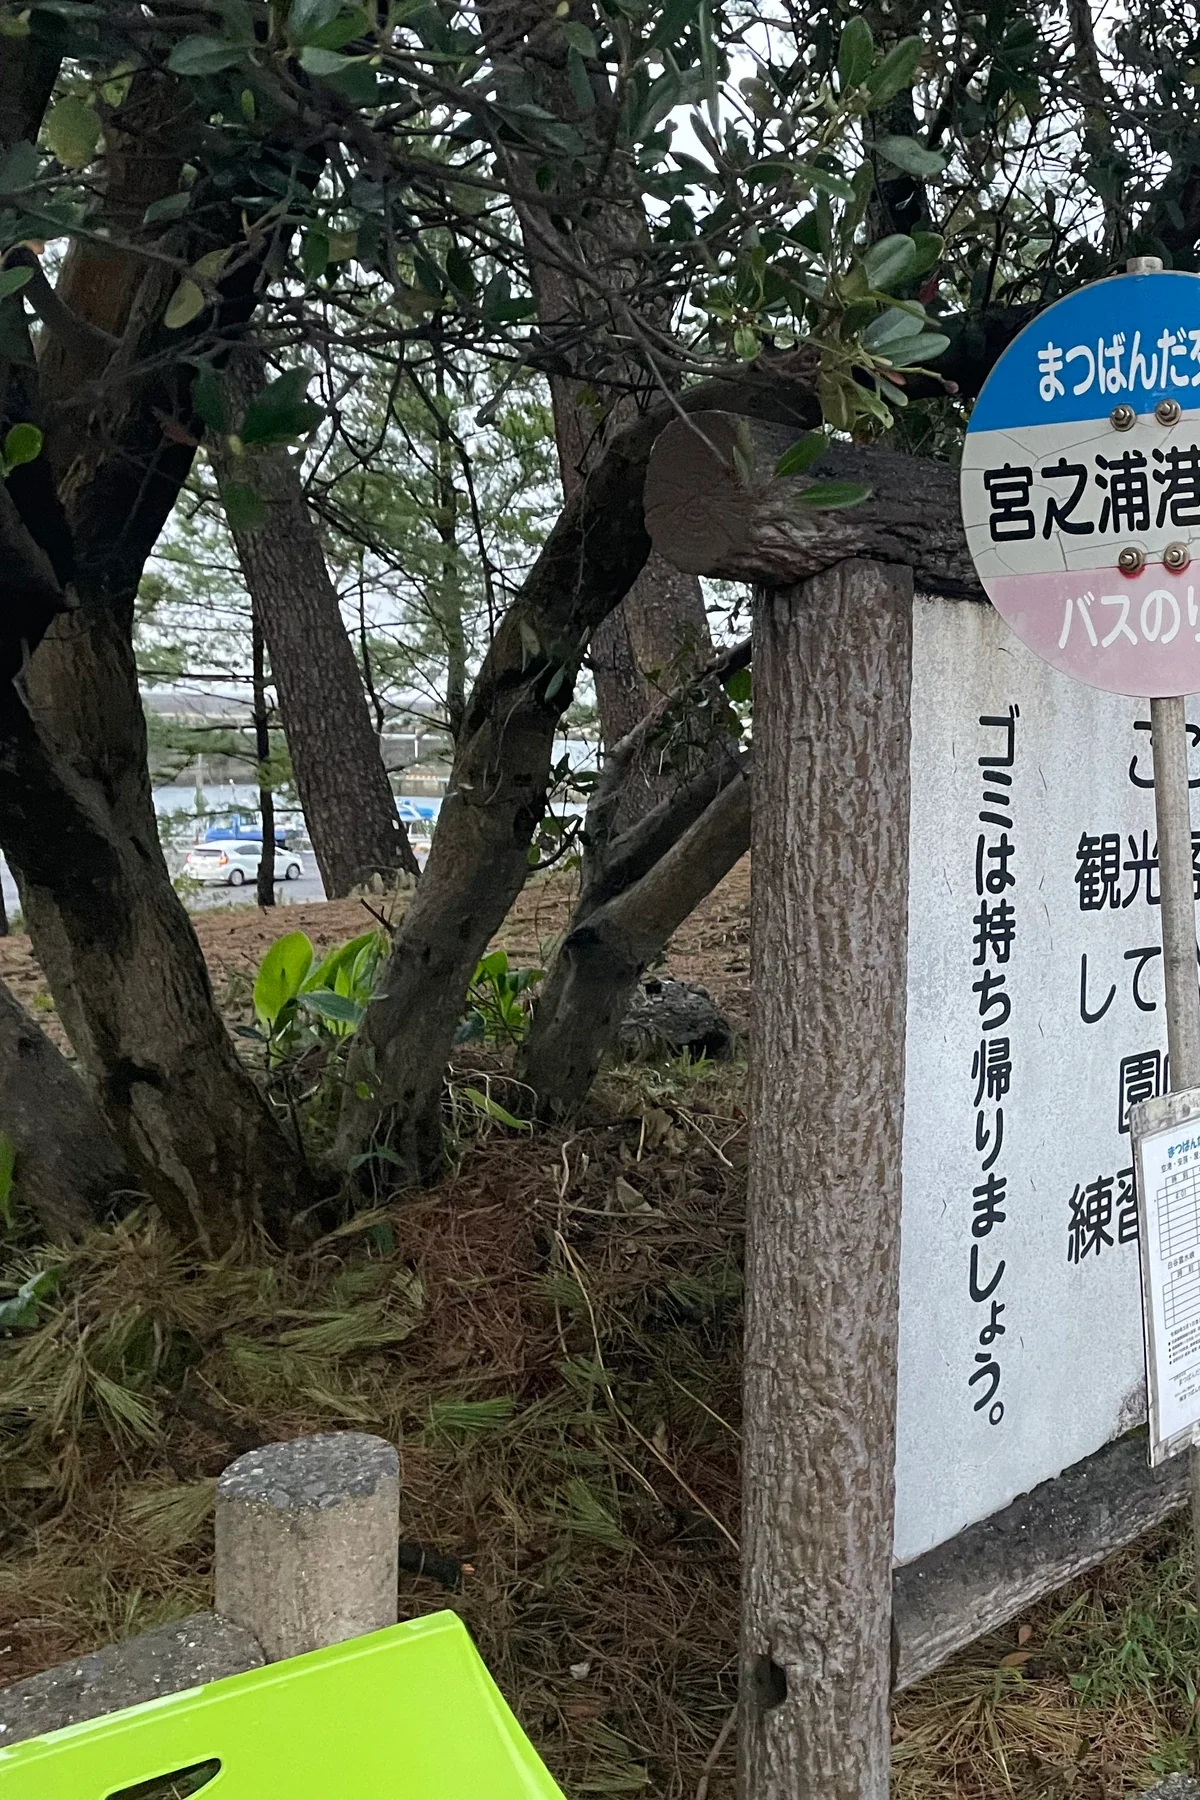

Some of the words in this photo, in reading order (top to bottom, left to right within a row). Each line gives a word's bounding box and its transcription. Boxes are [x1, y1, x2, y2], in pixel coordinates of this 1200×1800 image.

[967, 704, 1020, 1427] ゴミは持ち帰りましょう。
